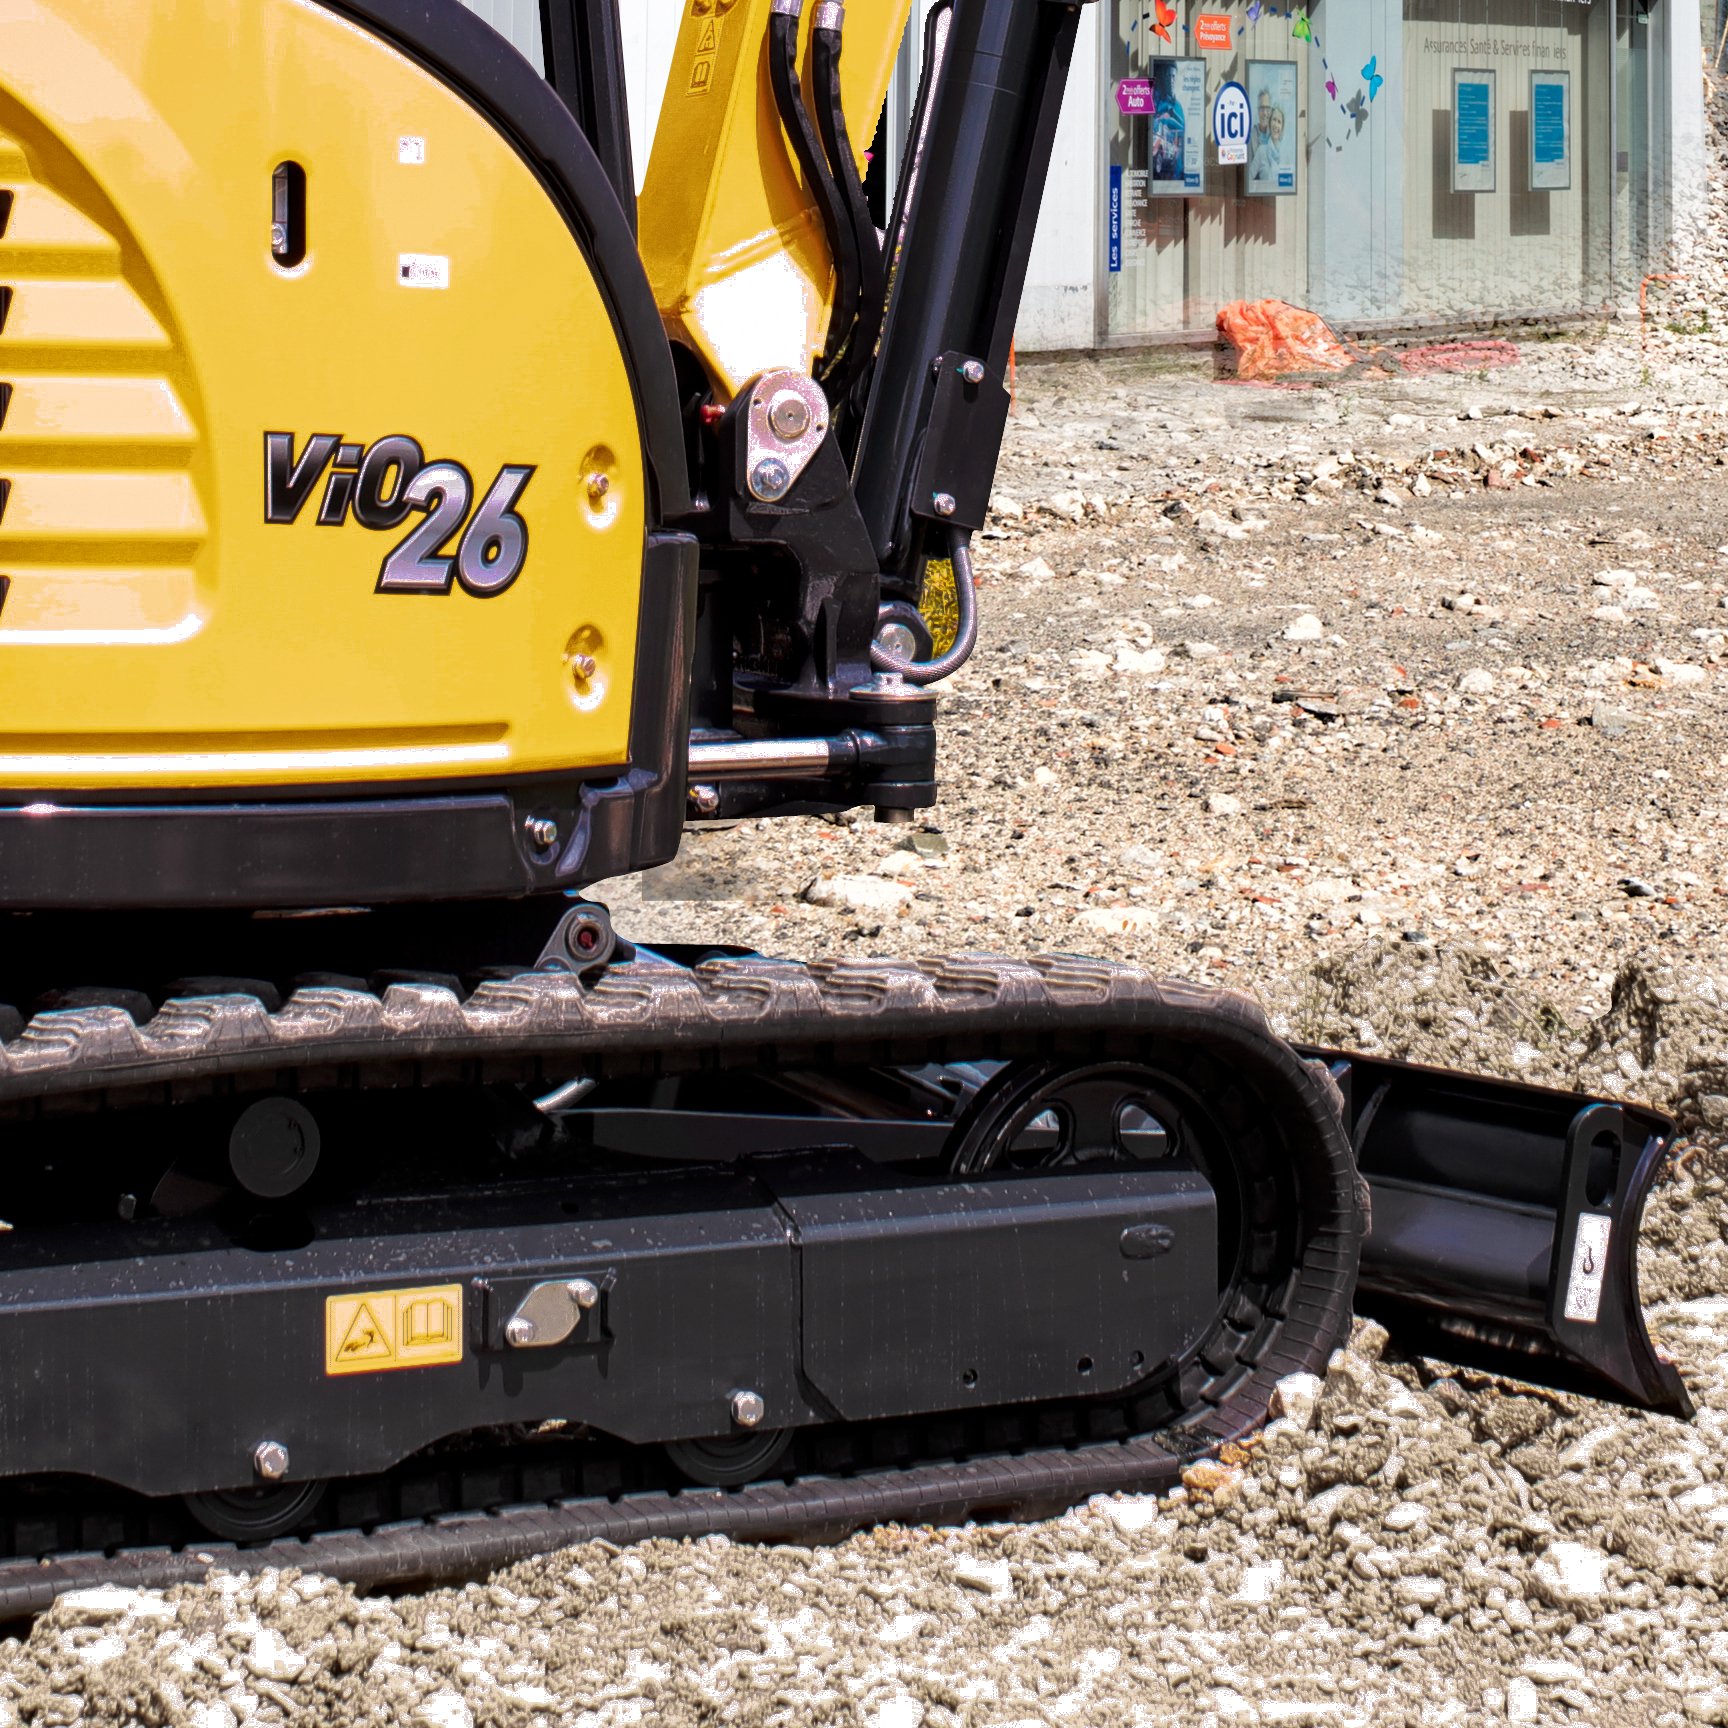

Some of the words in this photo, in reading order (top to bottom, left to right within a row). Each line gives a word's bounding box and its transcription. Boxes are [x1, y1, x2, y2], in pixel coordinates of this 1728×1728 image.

[1127, 95, 1145, 108] Auto
[1220, 103, 1244, 139] ici
[1110, 187, 1119, 240] services
[1110, 245, 1119, 267] Les
